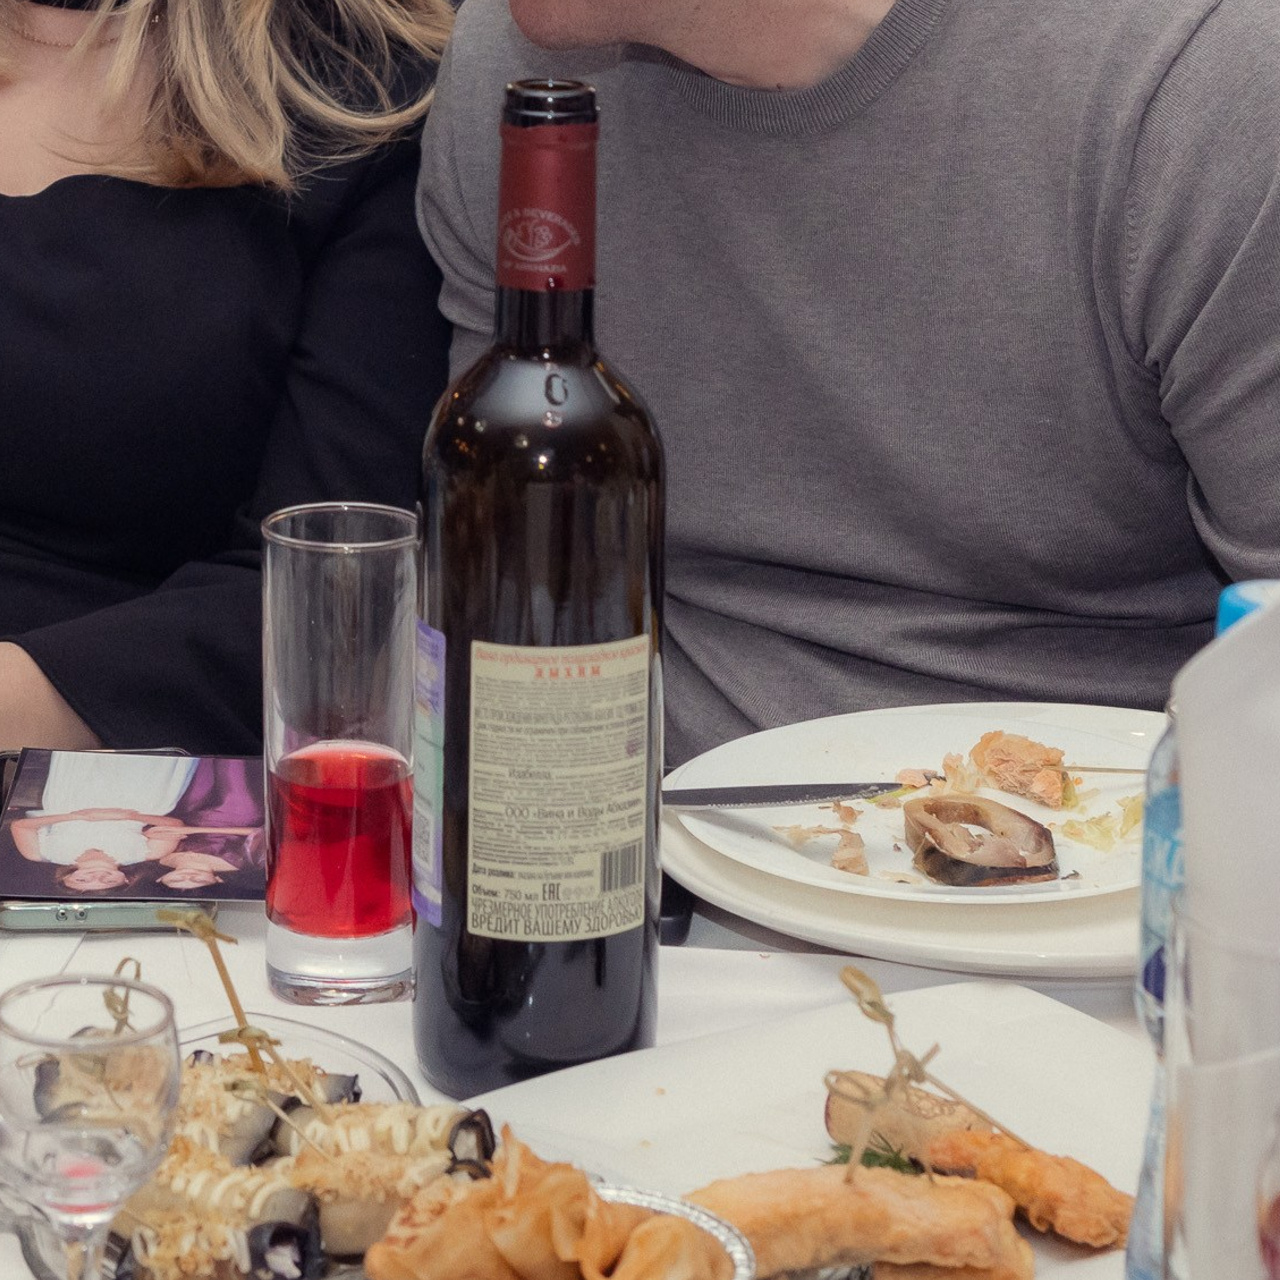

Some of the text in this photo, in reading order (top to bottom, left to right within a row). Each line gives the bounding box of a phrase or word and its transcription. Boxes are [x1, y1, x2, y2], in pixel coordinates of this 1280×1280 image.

[505, 806, 529, 819] ООО
[504, 888, 521, 901] 750
[525, 893, 538, 901] мл
[472, 898, 535, 919] ЧРЕЗМЕРНОЕ
[535, 899, 605, 921] УПОТРЕБЛЕНИЕ
[472, 905, 643, 936] ВРЕДИТ ВАШЕМУ ЗДОРОВЬЮ
